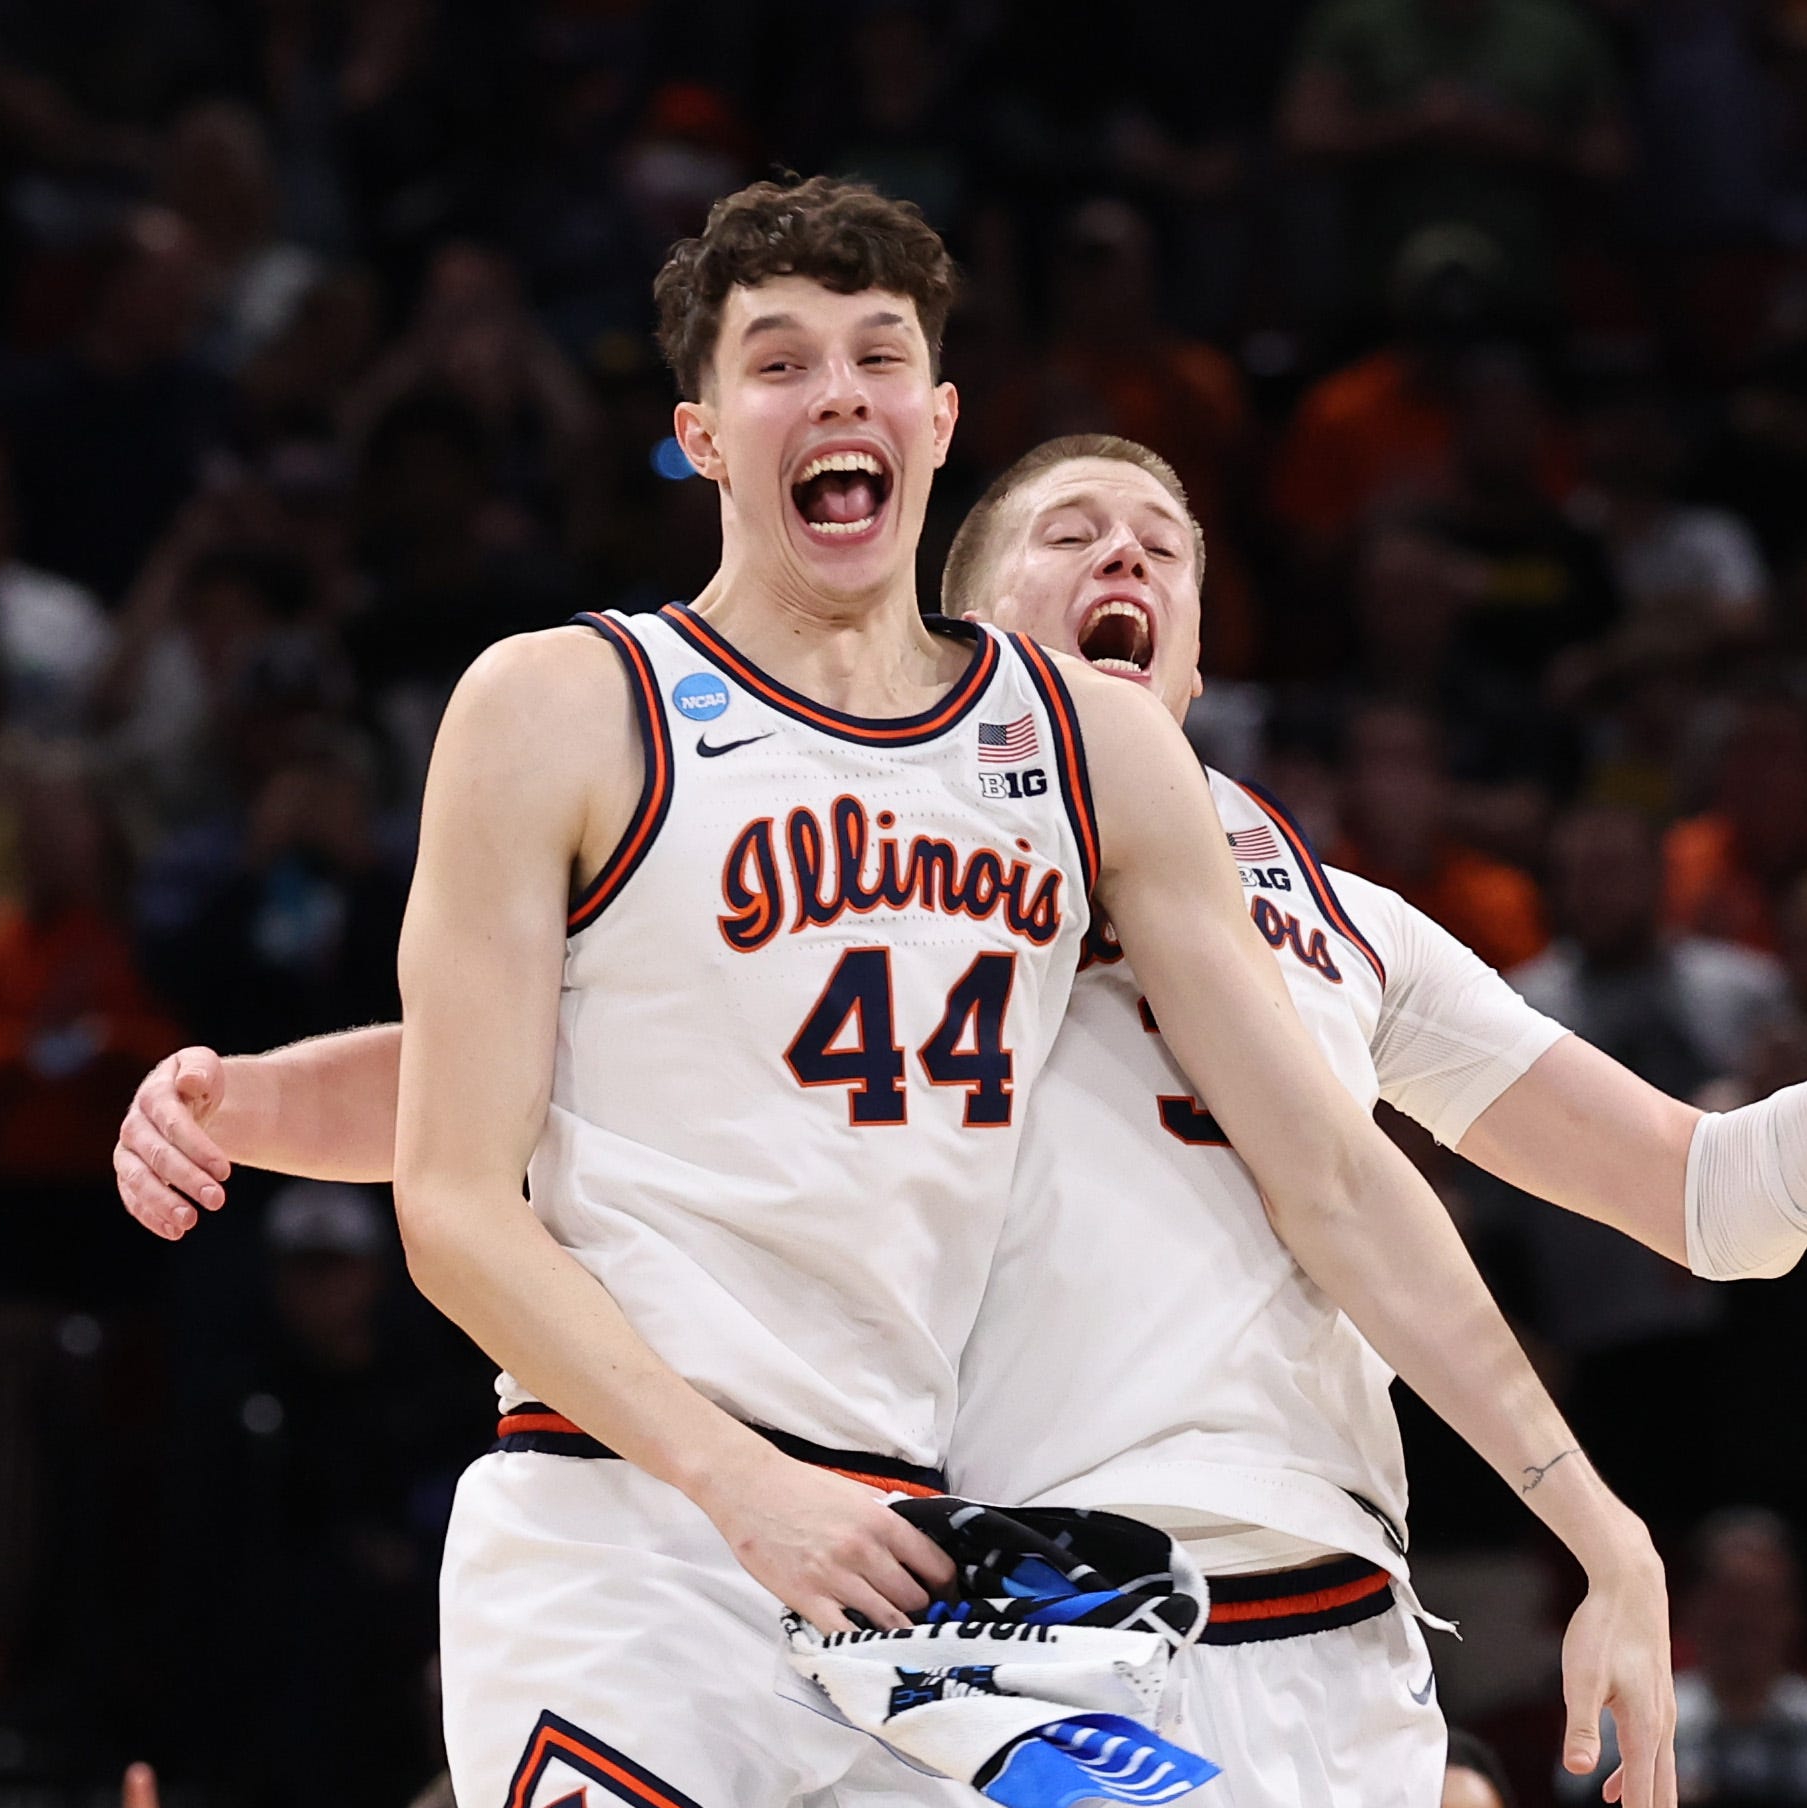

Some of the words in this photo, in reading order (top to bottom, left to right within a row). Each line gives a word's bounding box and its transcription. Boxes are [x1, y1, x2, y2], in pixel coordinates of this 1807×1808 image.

[680, 692, 727, 711] NCAA
[717, 793, 1063, 953] Illinois
[782, 946, 1028, 1128] 44
